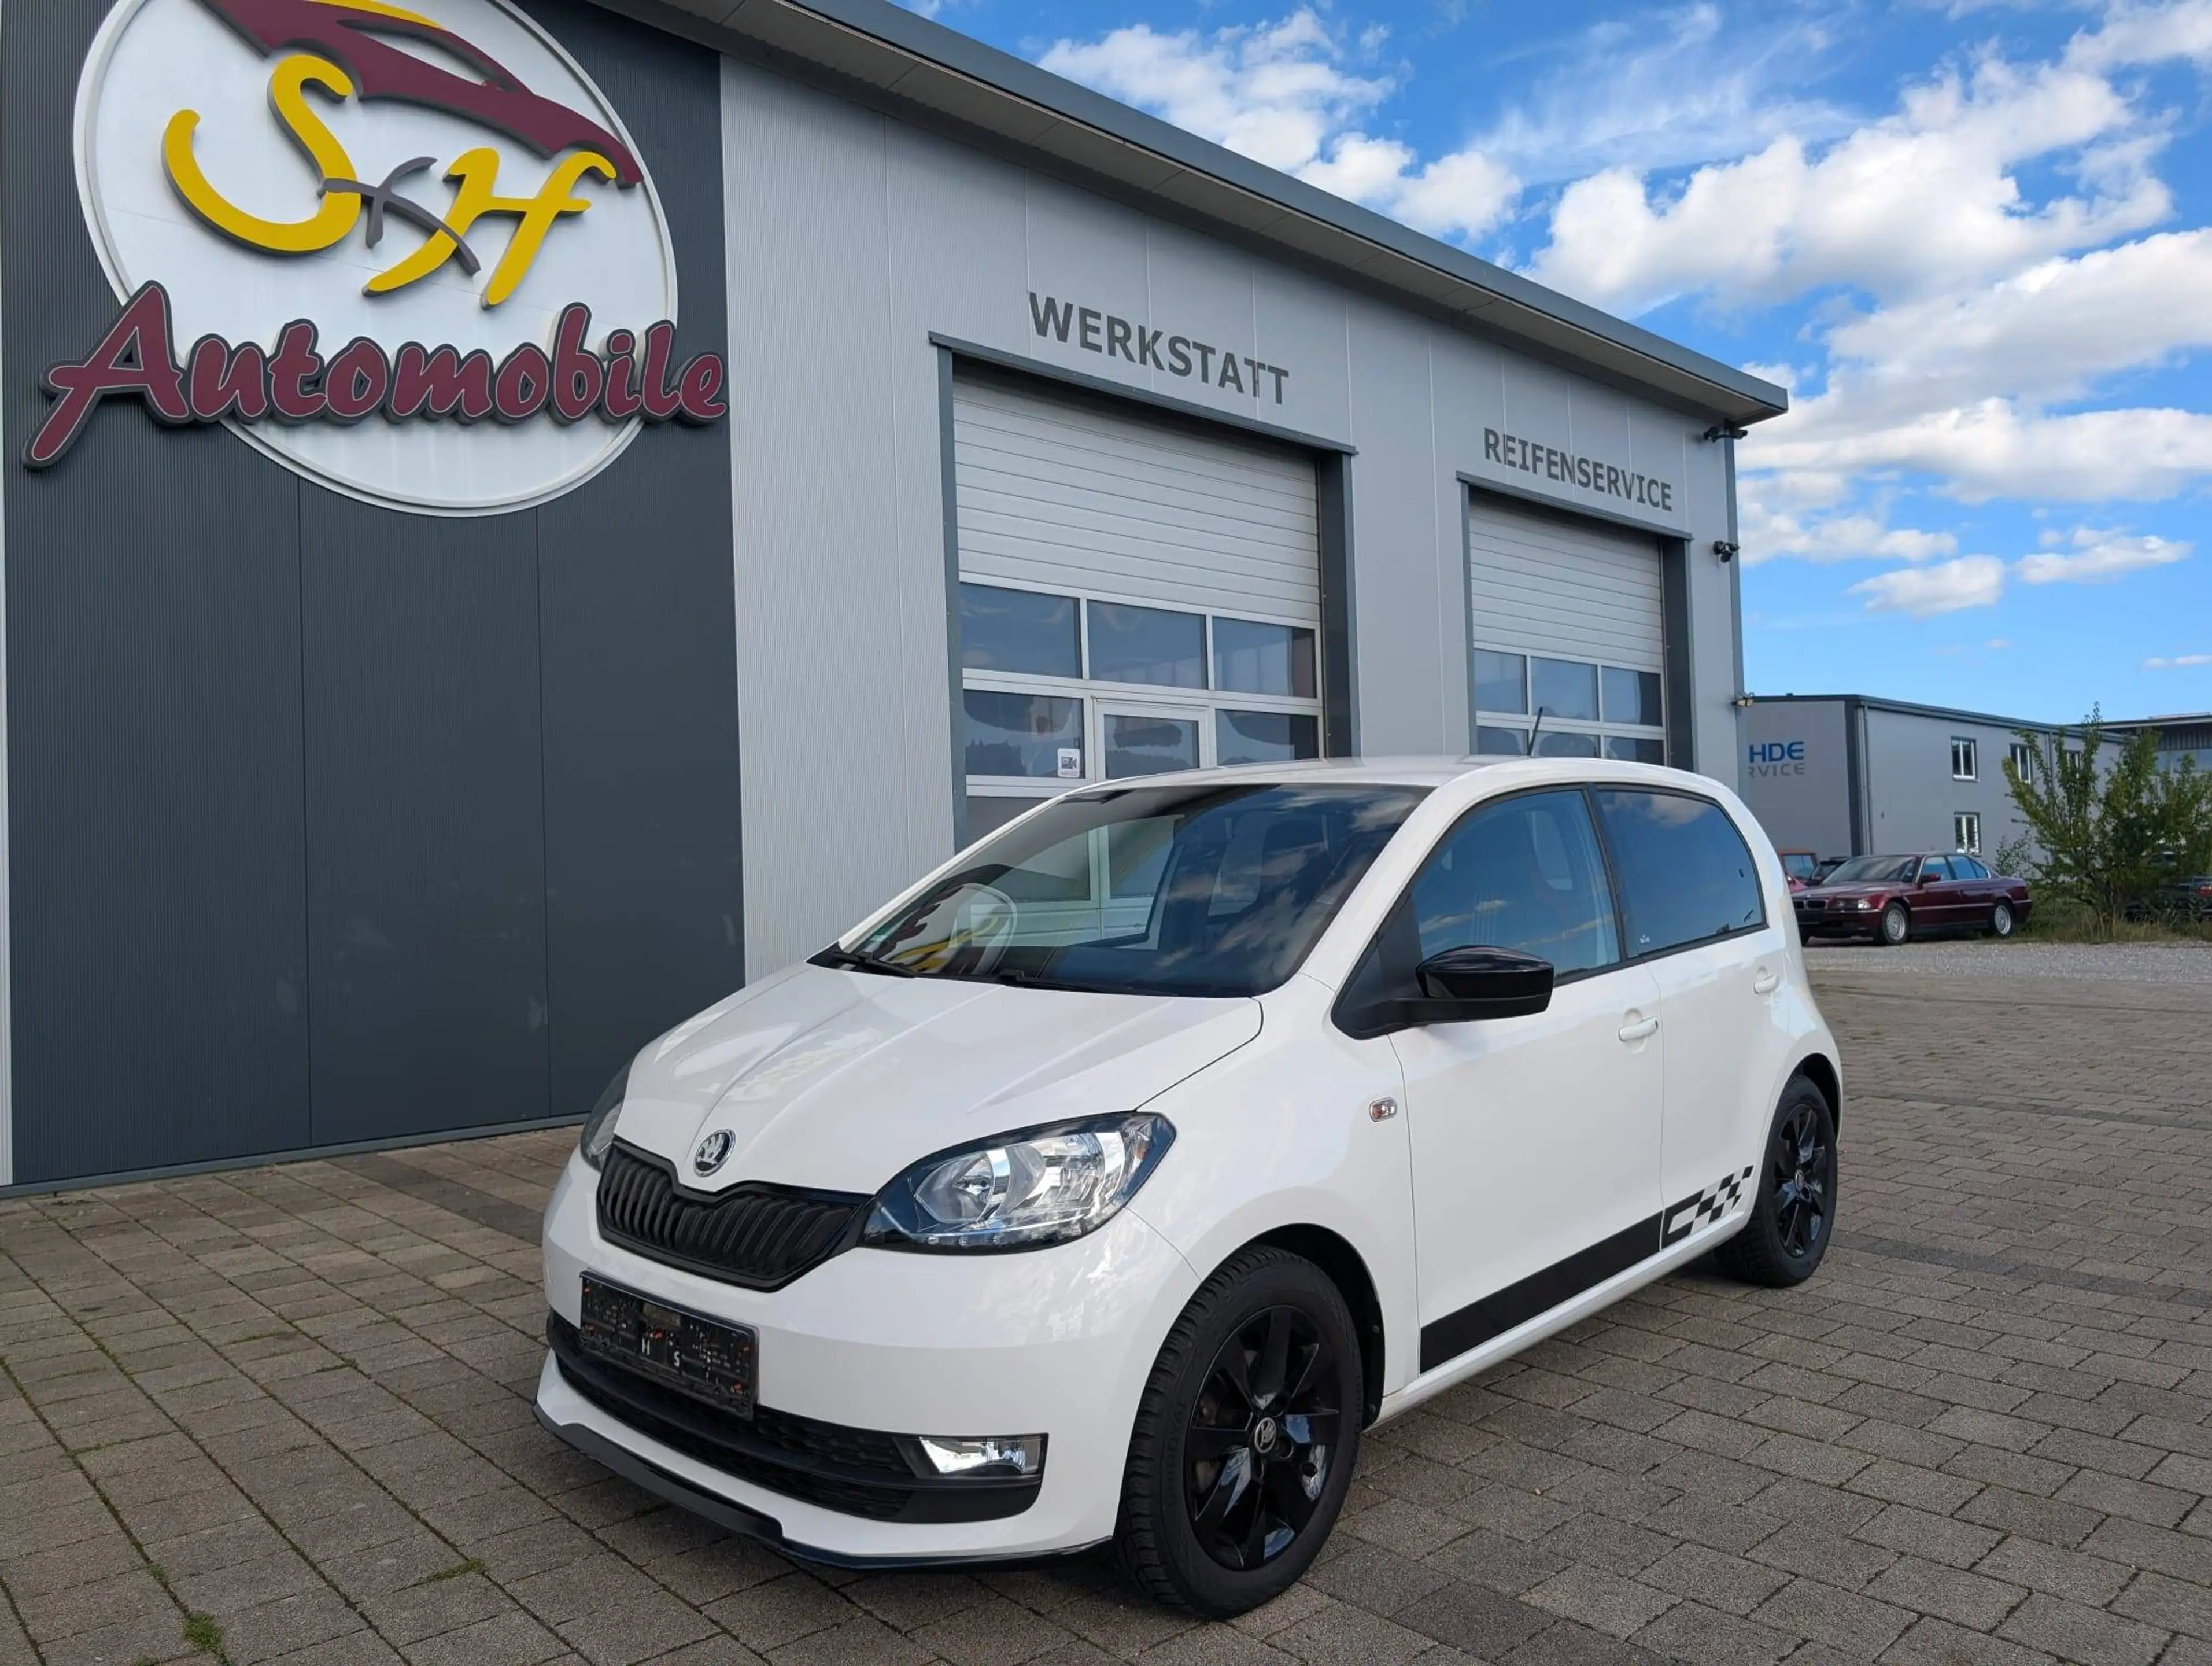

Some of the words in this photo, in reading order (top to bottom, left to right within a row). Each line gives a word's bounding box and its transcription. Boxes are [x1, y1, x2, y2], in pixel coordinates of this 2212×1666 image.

[22, 280, 729, 469] Automobile
[1029, 292, 1290, 404] WERKSTATT
[1483, 427, 1672, 511] REIFENSERVICE
